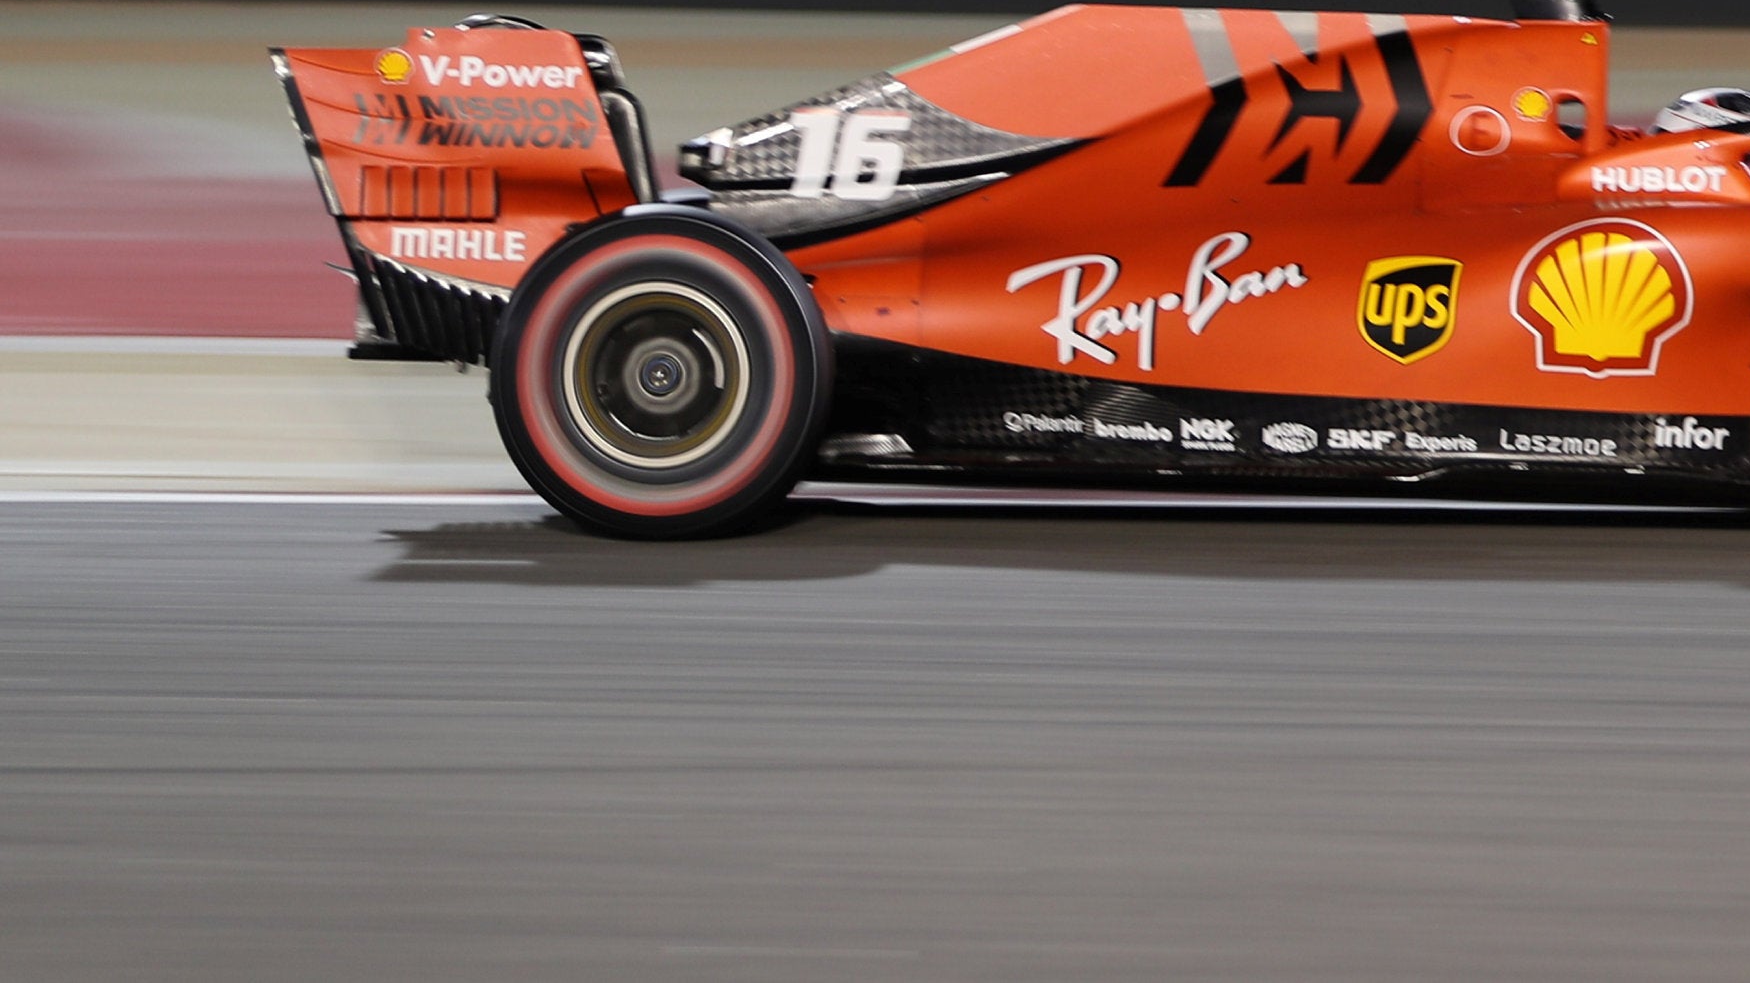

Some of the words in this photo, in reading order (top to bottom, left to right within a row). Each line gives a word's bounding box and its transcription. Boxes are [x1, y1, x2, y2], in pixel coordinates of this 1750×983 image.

[418, 54, 583, 89] V-Power
[416, 94, 598, 122] MISSION
[417, 122, 599, 149] WINNOW
[790, 110, 910, 200] 16
[1590, 166, 1727, 193] HUBLOT
[390, 227, 526, 262] MAHLE
[1093, 417, 1173, 443] brembo
[1179, 417, 1236, 442] NGK
[1327, 428, 1396, 451] SKF
[1654, 417, 1730, 451] infor
